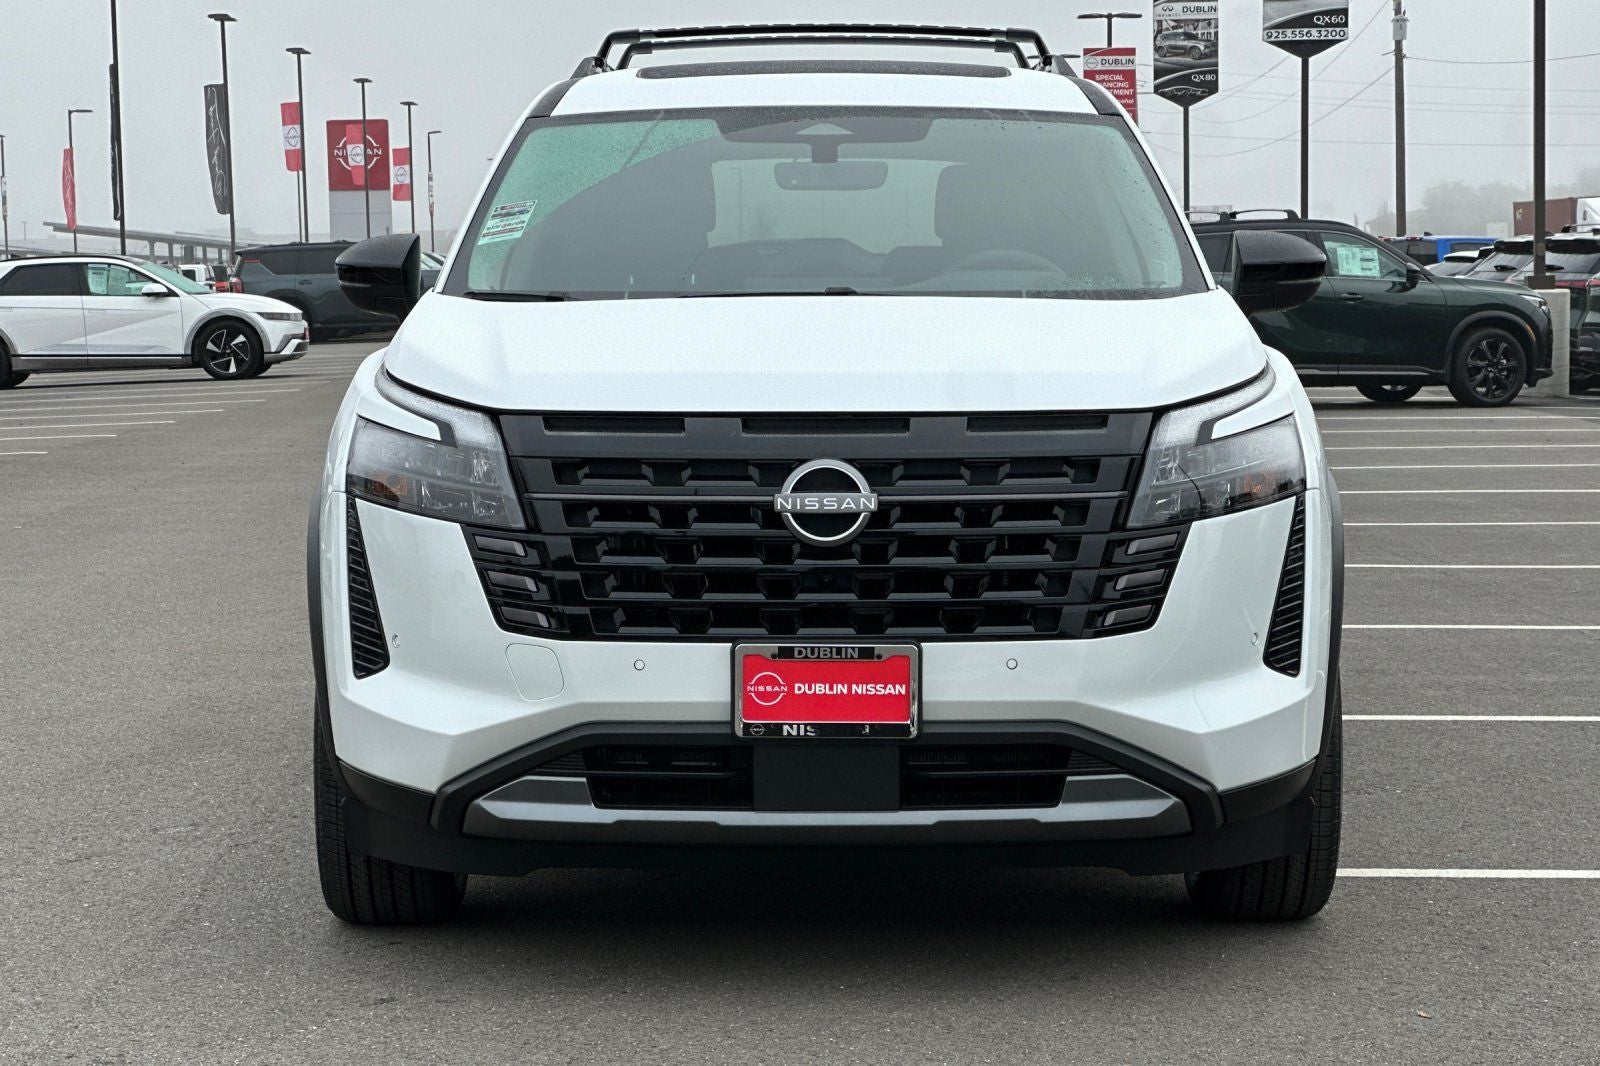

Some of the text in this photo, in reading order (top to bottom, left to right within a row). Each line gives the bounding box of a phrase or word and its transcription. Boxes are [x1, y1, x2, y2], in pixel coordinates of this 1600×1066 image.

[1182, 5, 1217, 13] DUBLIN
[1313, 15, 1346, 25] QX60
[1265, 29, 1346, 40] 925.556.3200
[1100, 58, 1135, 66] DUBLIN
[1191, 74, 1216, 82] QX80
[334, 148, 382, 157] NIAN
[777, 497, 875, 510] NISSAN
[793, 647, 859, 659] DUBLIN
[794, 683, 906, 695] DUBLIN NISSAN
